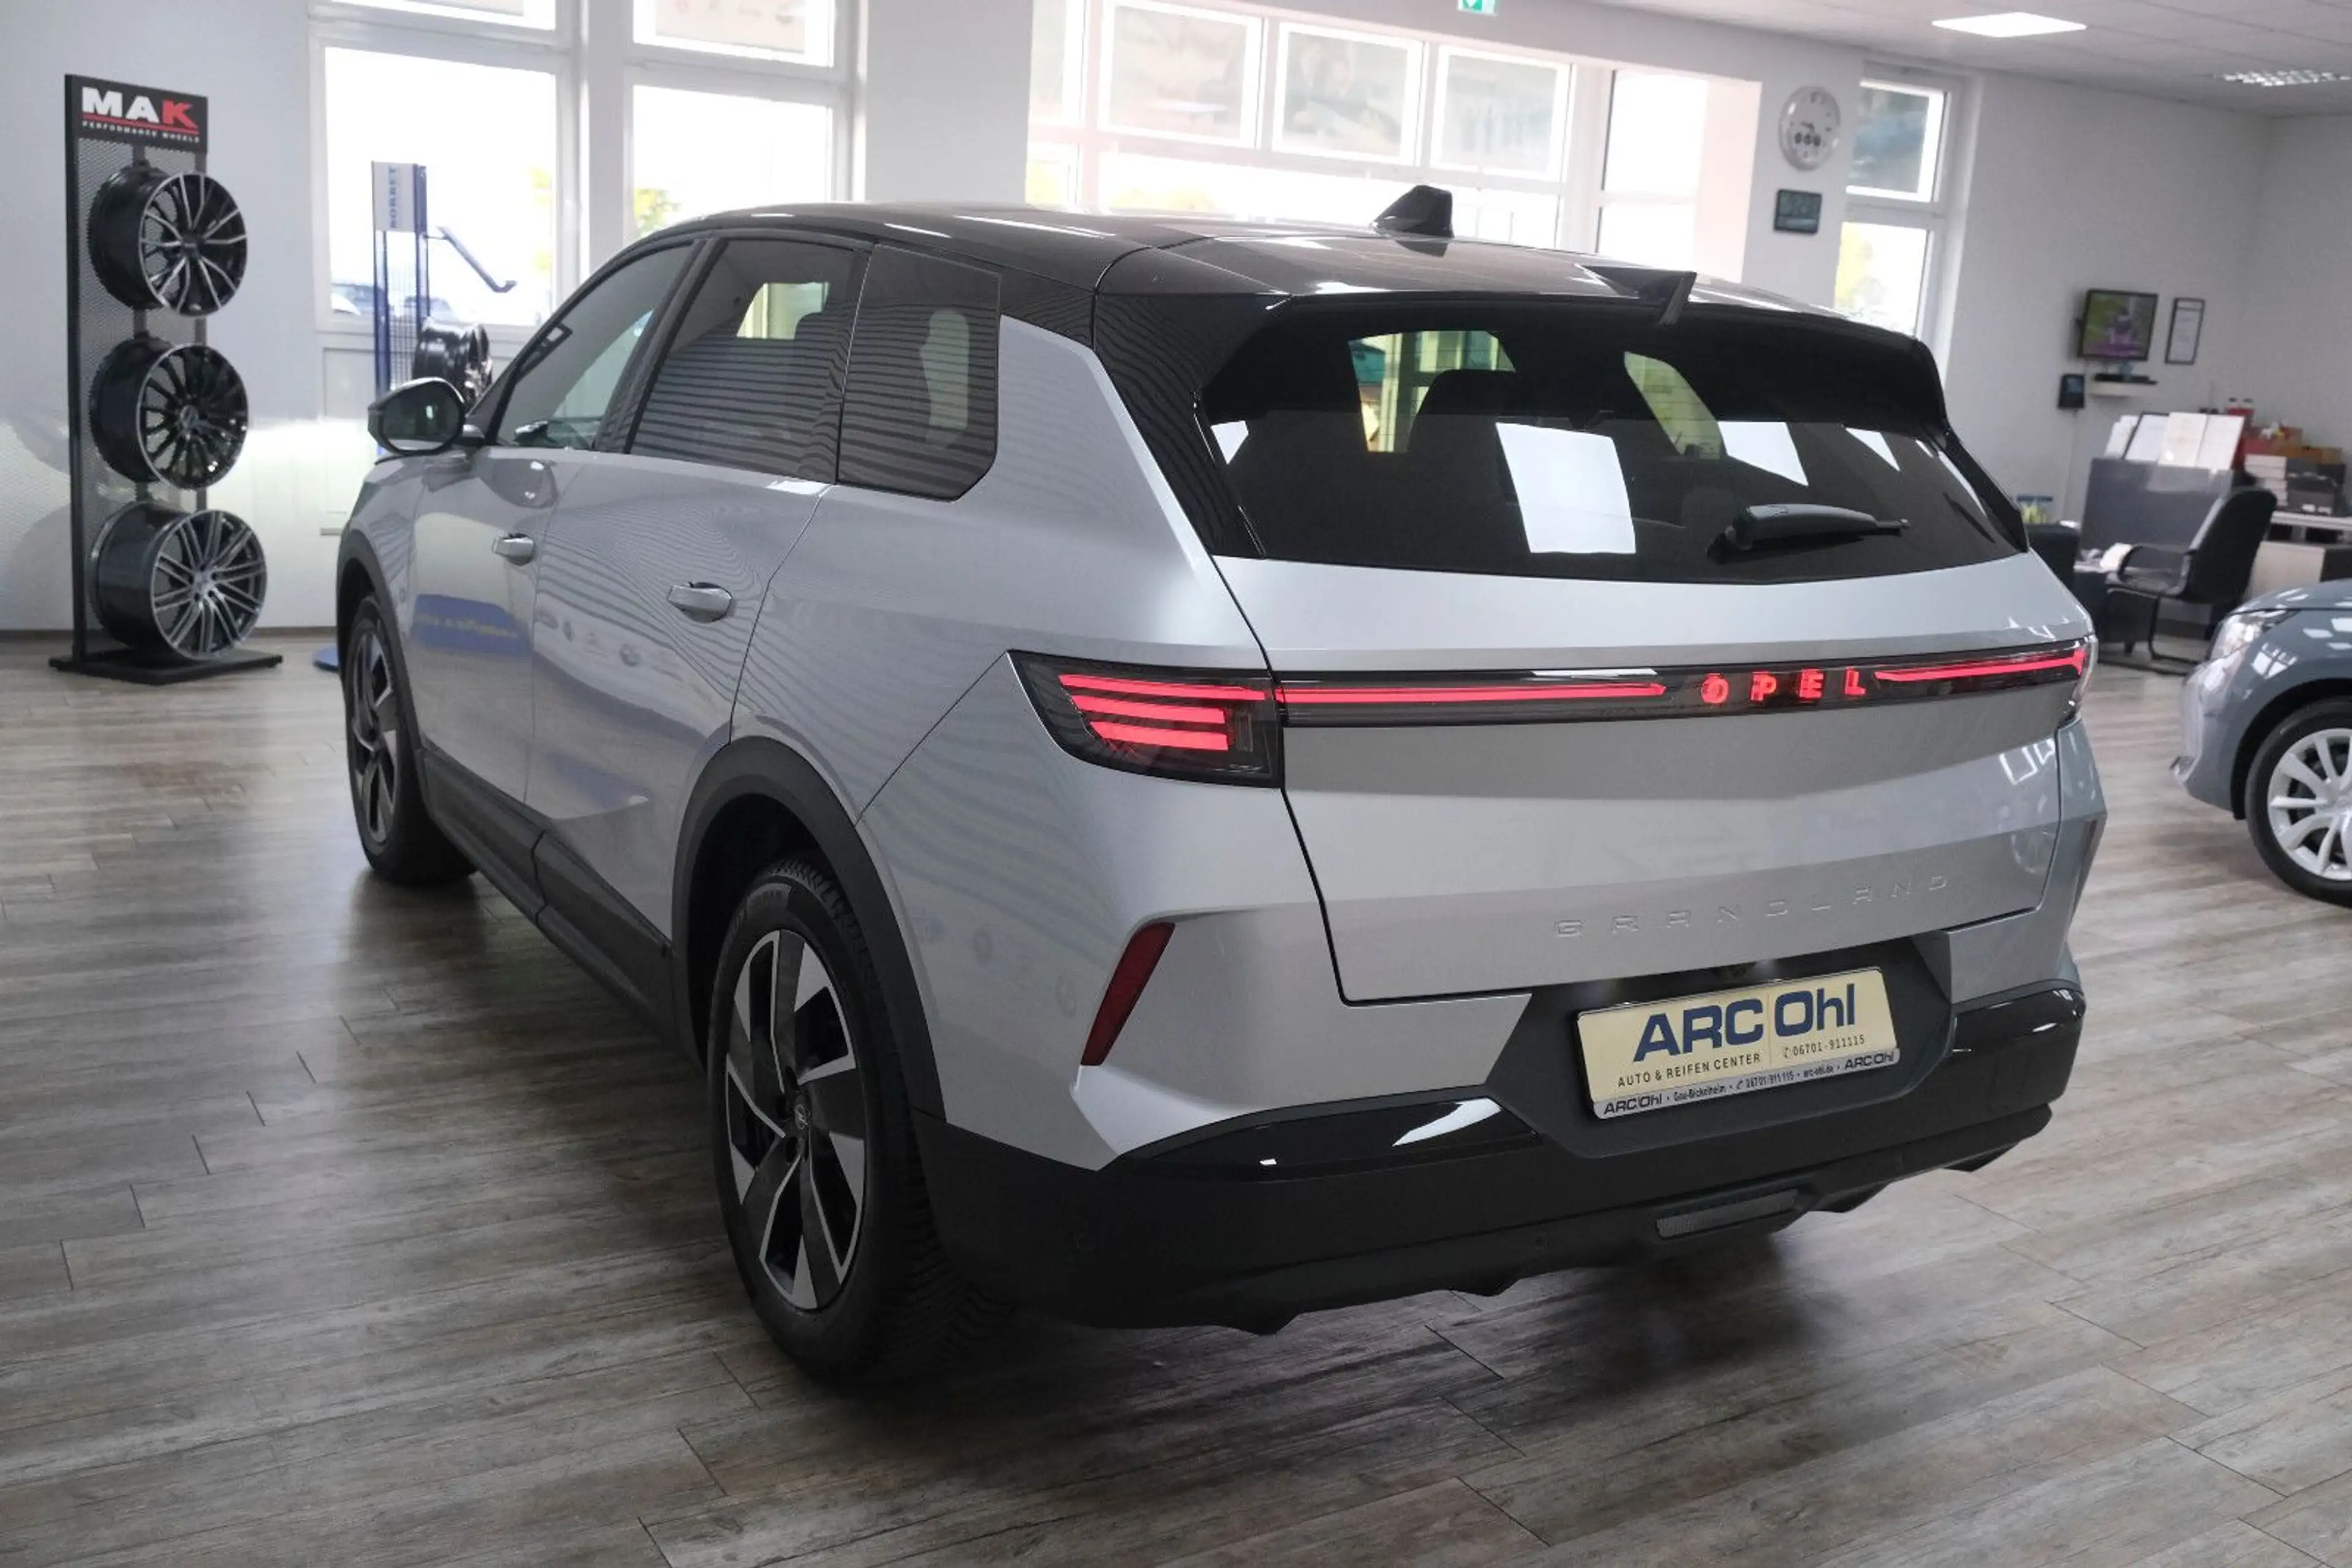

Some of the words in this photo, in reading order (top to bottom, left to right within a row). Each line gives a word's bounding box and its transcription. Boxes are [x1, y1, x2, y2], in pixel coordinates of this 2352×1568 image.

[82, 86, 198, 129] MAK
[82, 121, 157, 137] PERFORMANCE
[162, 132, 200, 143] WHEELS
[1700, 668, 1866, 704] OPEL
[1555, 875, 1948, 938] GRANDLAND
[1618, 1072, 1651, 1087] AUTO
[1655, 1069, 1662, 1080] &
[1667, 1062, 1709, 1079] REIFEN
[1714, 1053, 1760, 1071] CENTER
